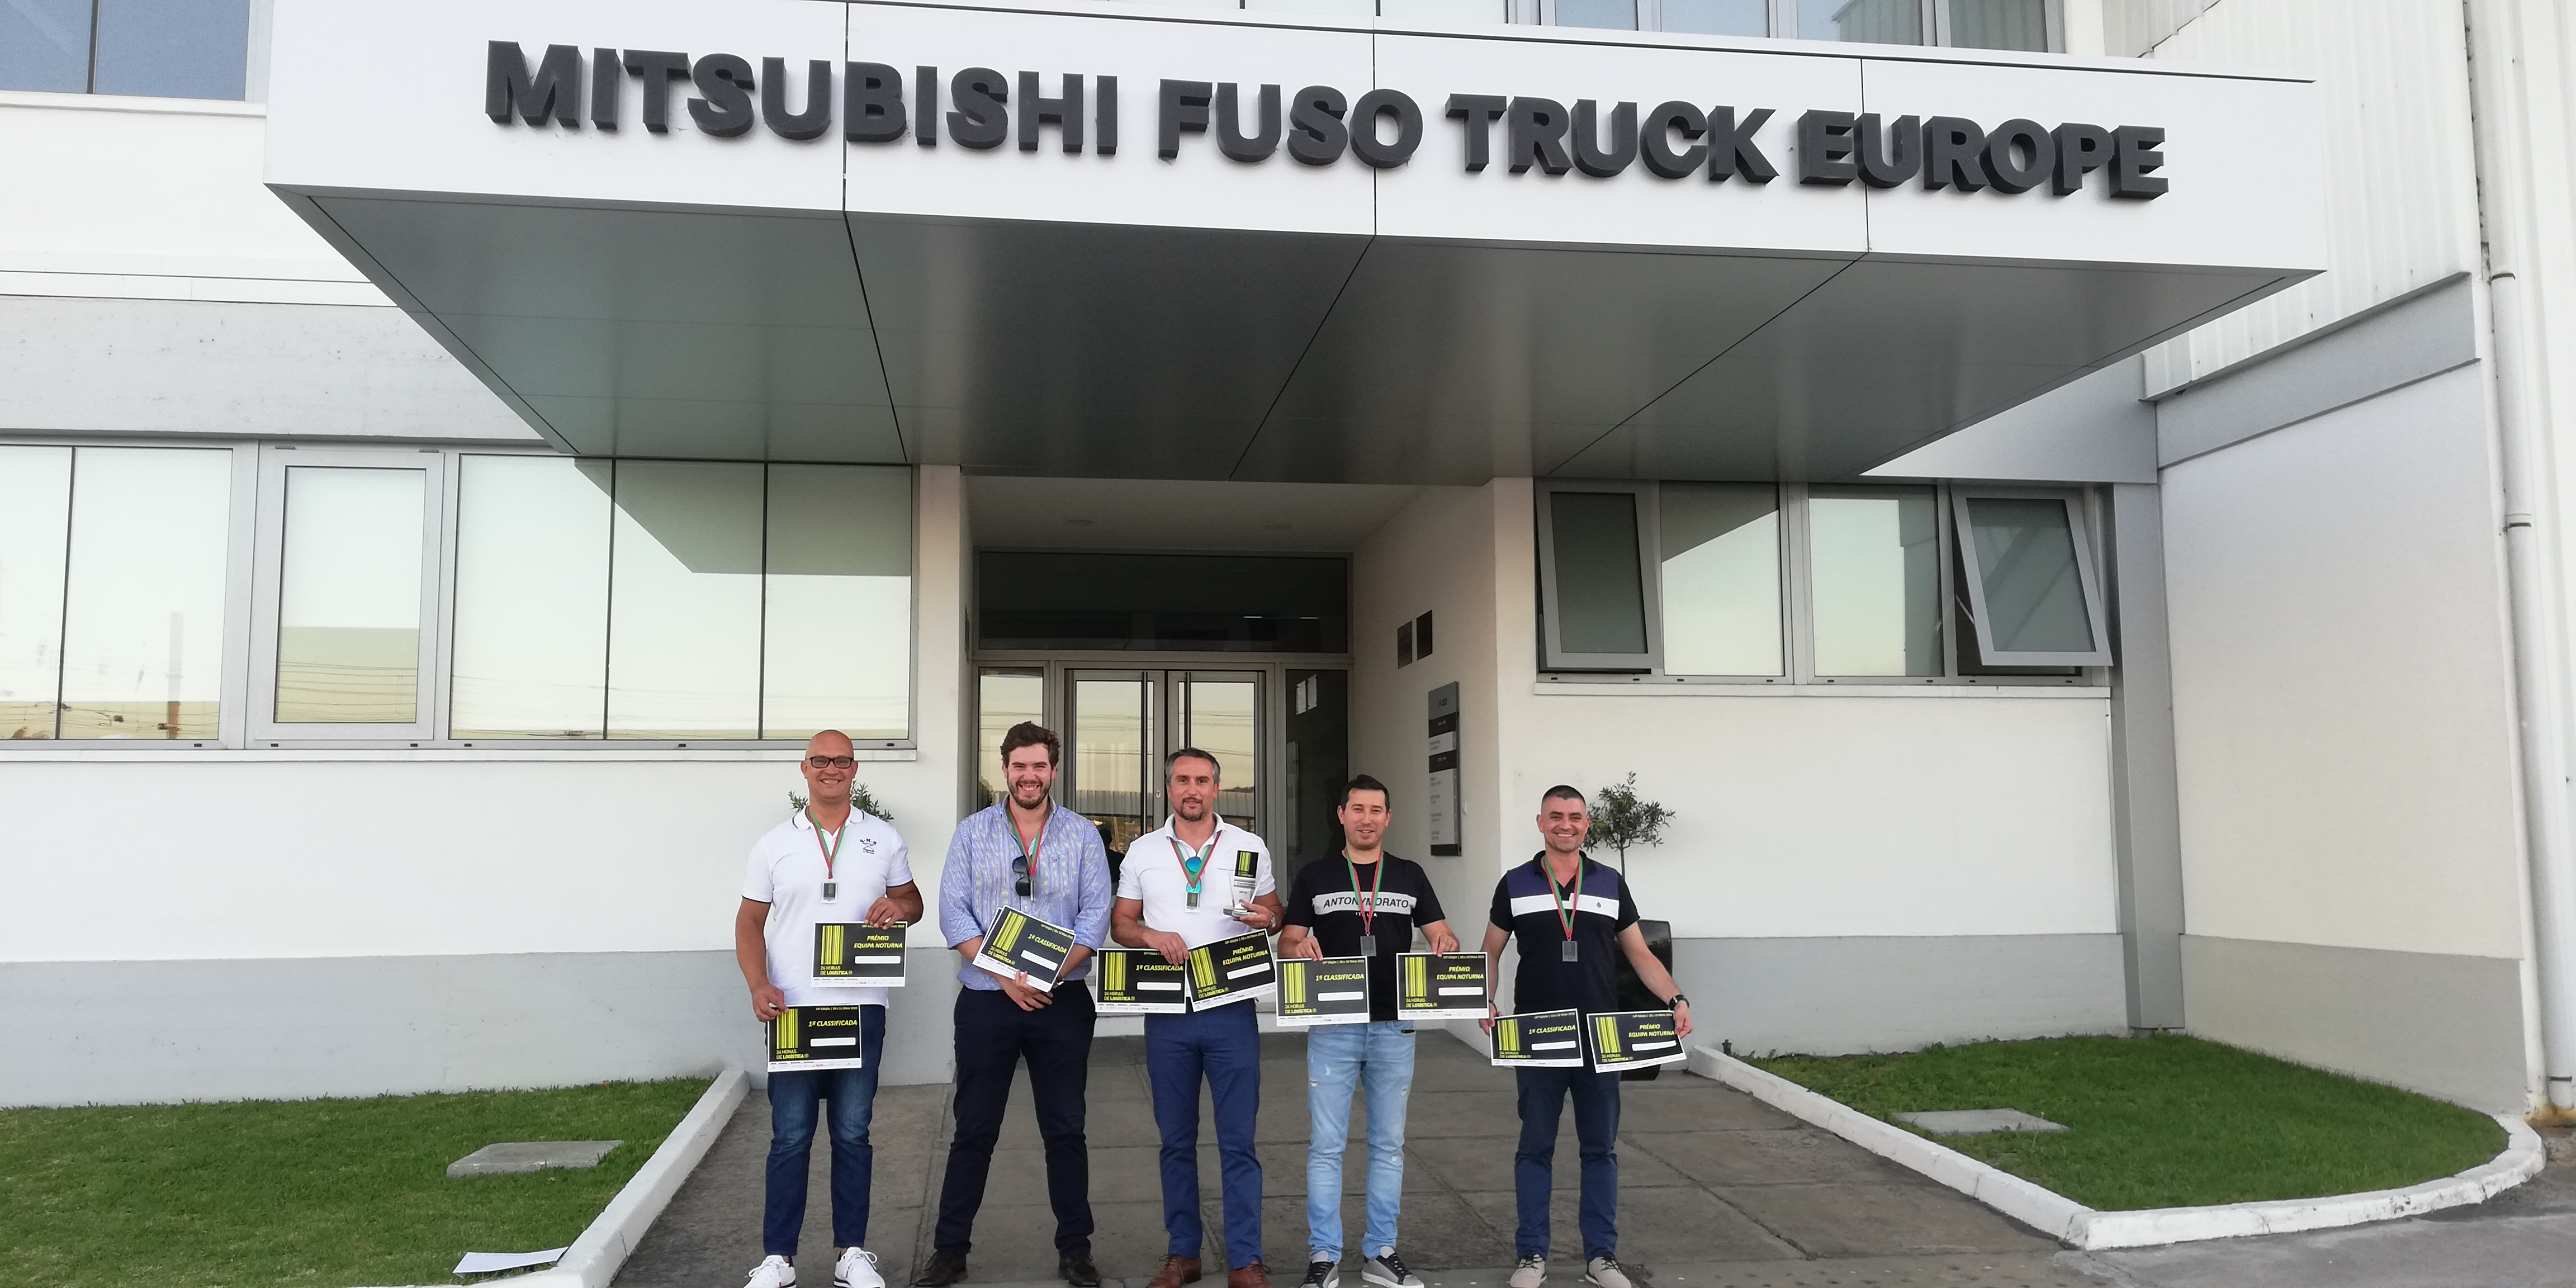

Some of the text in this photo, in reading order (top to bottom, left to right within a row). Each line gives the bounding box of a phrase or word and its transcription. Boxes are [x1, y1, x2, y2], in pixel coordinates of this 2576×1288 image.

[485, 40, 2169, 200] MITSUBISHI FUSO TRUCK EUROPE
[1034, 936, 1067, 954] CLASSIFICADA
[1223, 950, 1268, 965] EQUIPA NOTURNA
